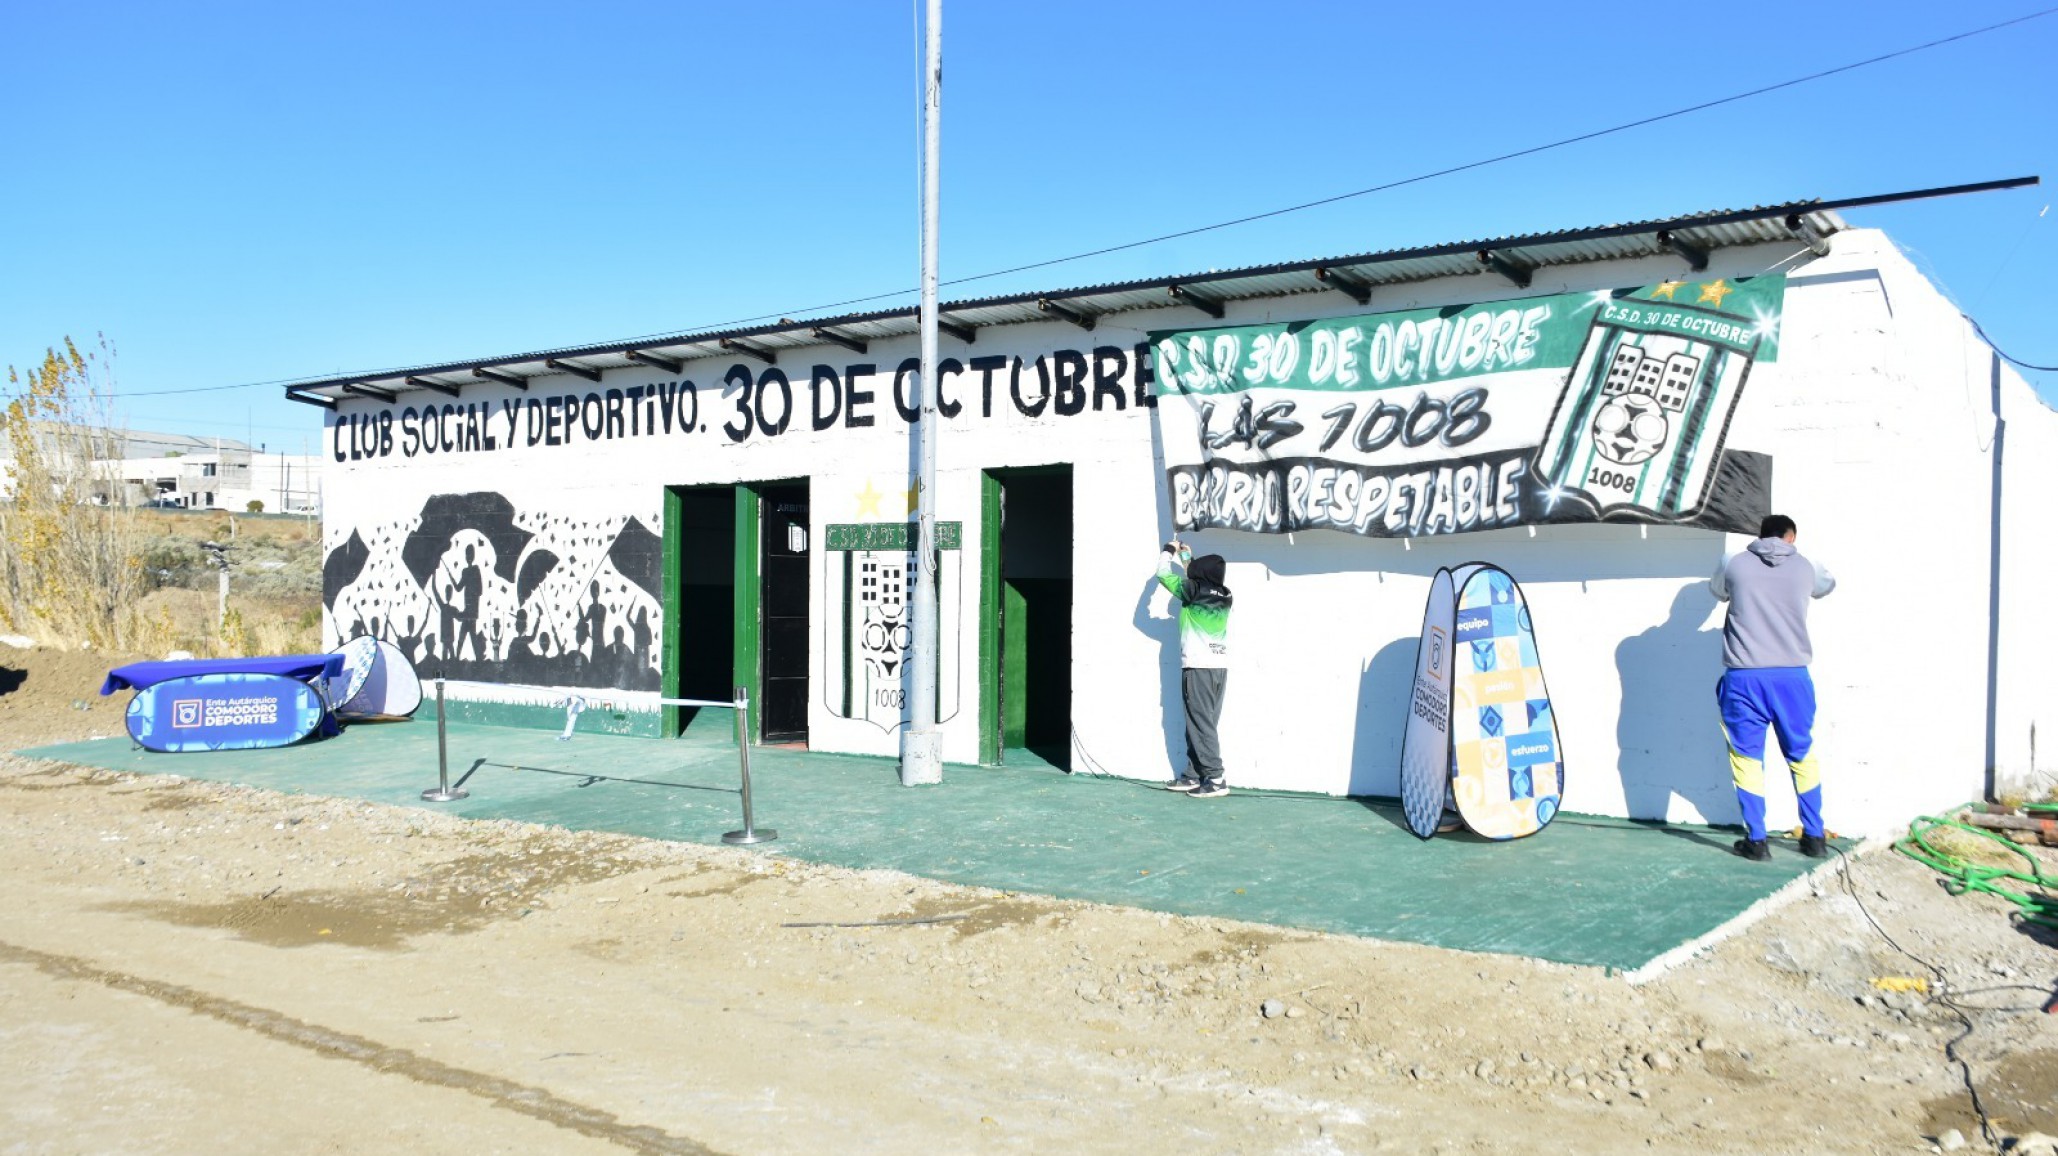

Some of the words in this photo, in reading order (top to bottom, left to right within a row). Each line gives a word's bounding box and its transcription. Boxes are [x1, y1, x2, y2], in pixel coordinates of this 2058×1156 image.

[1604, 306, 1640, 323] C.S.D.
[1644, 313, 1660, 325] 30
[1661, 313, 1681, 328] DE
[1682, 316, 1752, 344] OCTUBRE
[1243, 332, 1300, 384] 30
[1308, 326, 1363, 387] DE
[1369, 304, 1551, 384] OCTUBRE
[334, 410, 393, 462] CLUB
[503, 397, 522, 448] Y
[723, 364, 792, 443] 30
[812, 364, 876, 431] DE
[893, 342, 1158, 423] OCTUBRE
[1201, 394, 1304, 450] LAS
[1319, 388, 1492, 453] 1008
[1588, 467, 1636, 494] 1008
[1174, 466, 1281, 532] BARRIO
[1288, 457, 1525, 536] RESPETABLE
[1457, 618, 1489, 631] equipo
[205, 704, 278, 715] COMODORO
[206, 698, 226, 706] Ente
[875, 688, 906, 710] 1008
[205, 713, 278, 726] DEPORTES
[1414, 700, 1446, 733] DEPORTES
[1511, 744, 1549, 757] esfuerzo
